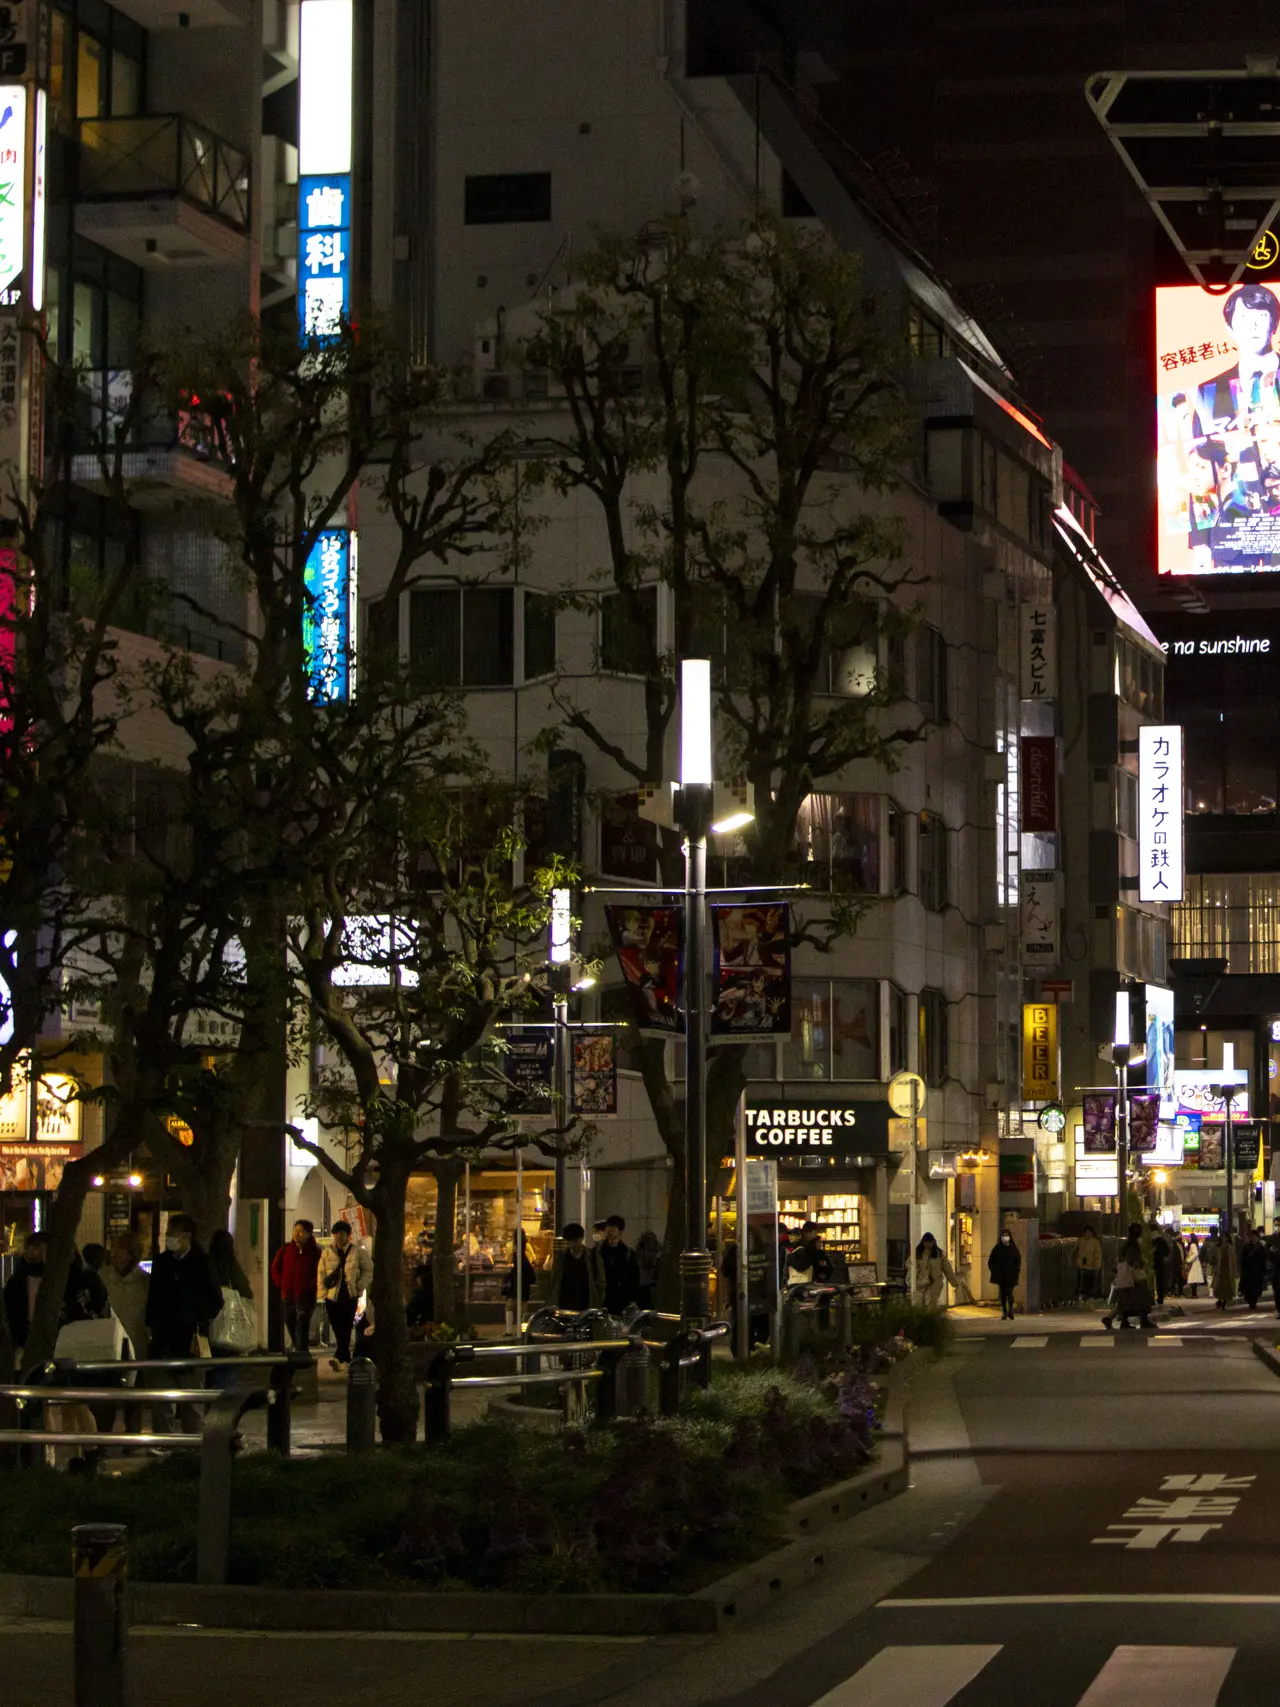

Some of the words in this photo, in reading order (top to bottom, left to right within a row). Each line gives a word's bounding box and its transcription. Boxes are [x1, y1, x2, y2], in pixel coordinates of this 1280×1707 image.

[1199, 635, 1270, 655] sunshine
[1151, 737, 1170, 889] カラオケの鉄人
[1034, 1008, 1049, 1080] BEER
[745, 1110, 856, 1126] TARBUCKS
[755, 1128, 833, 1145] COFFEE
